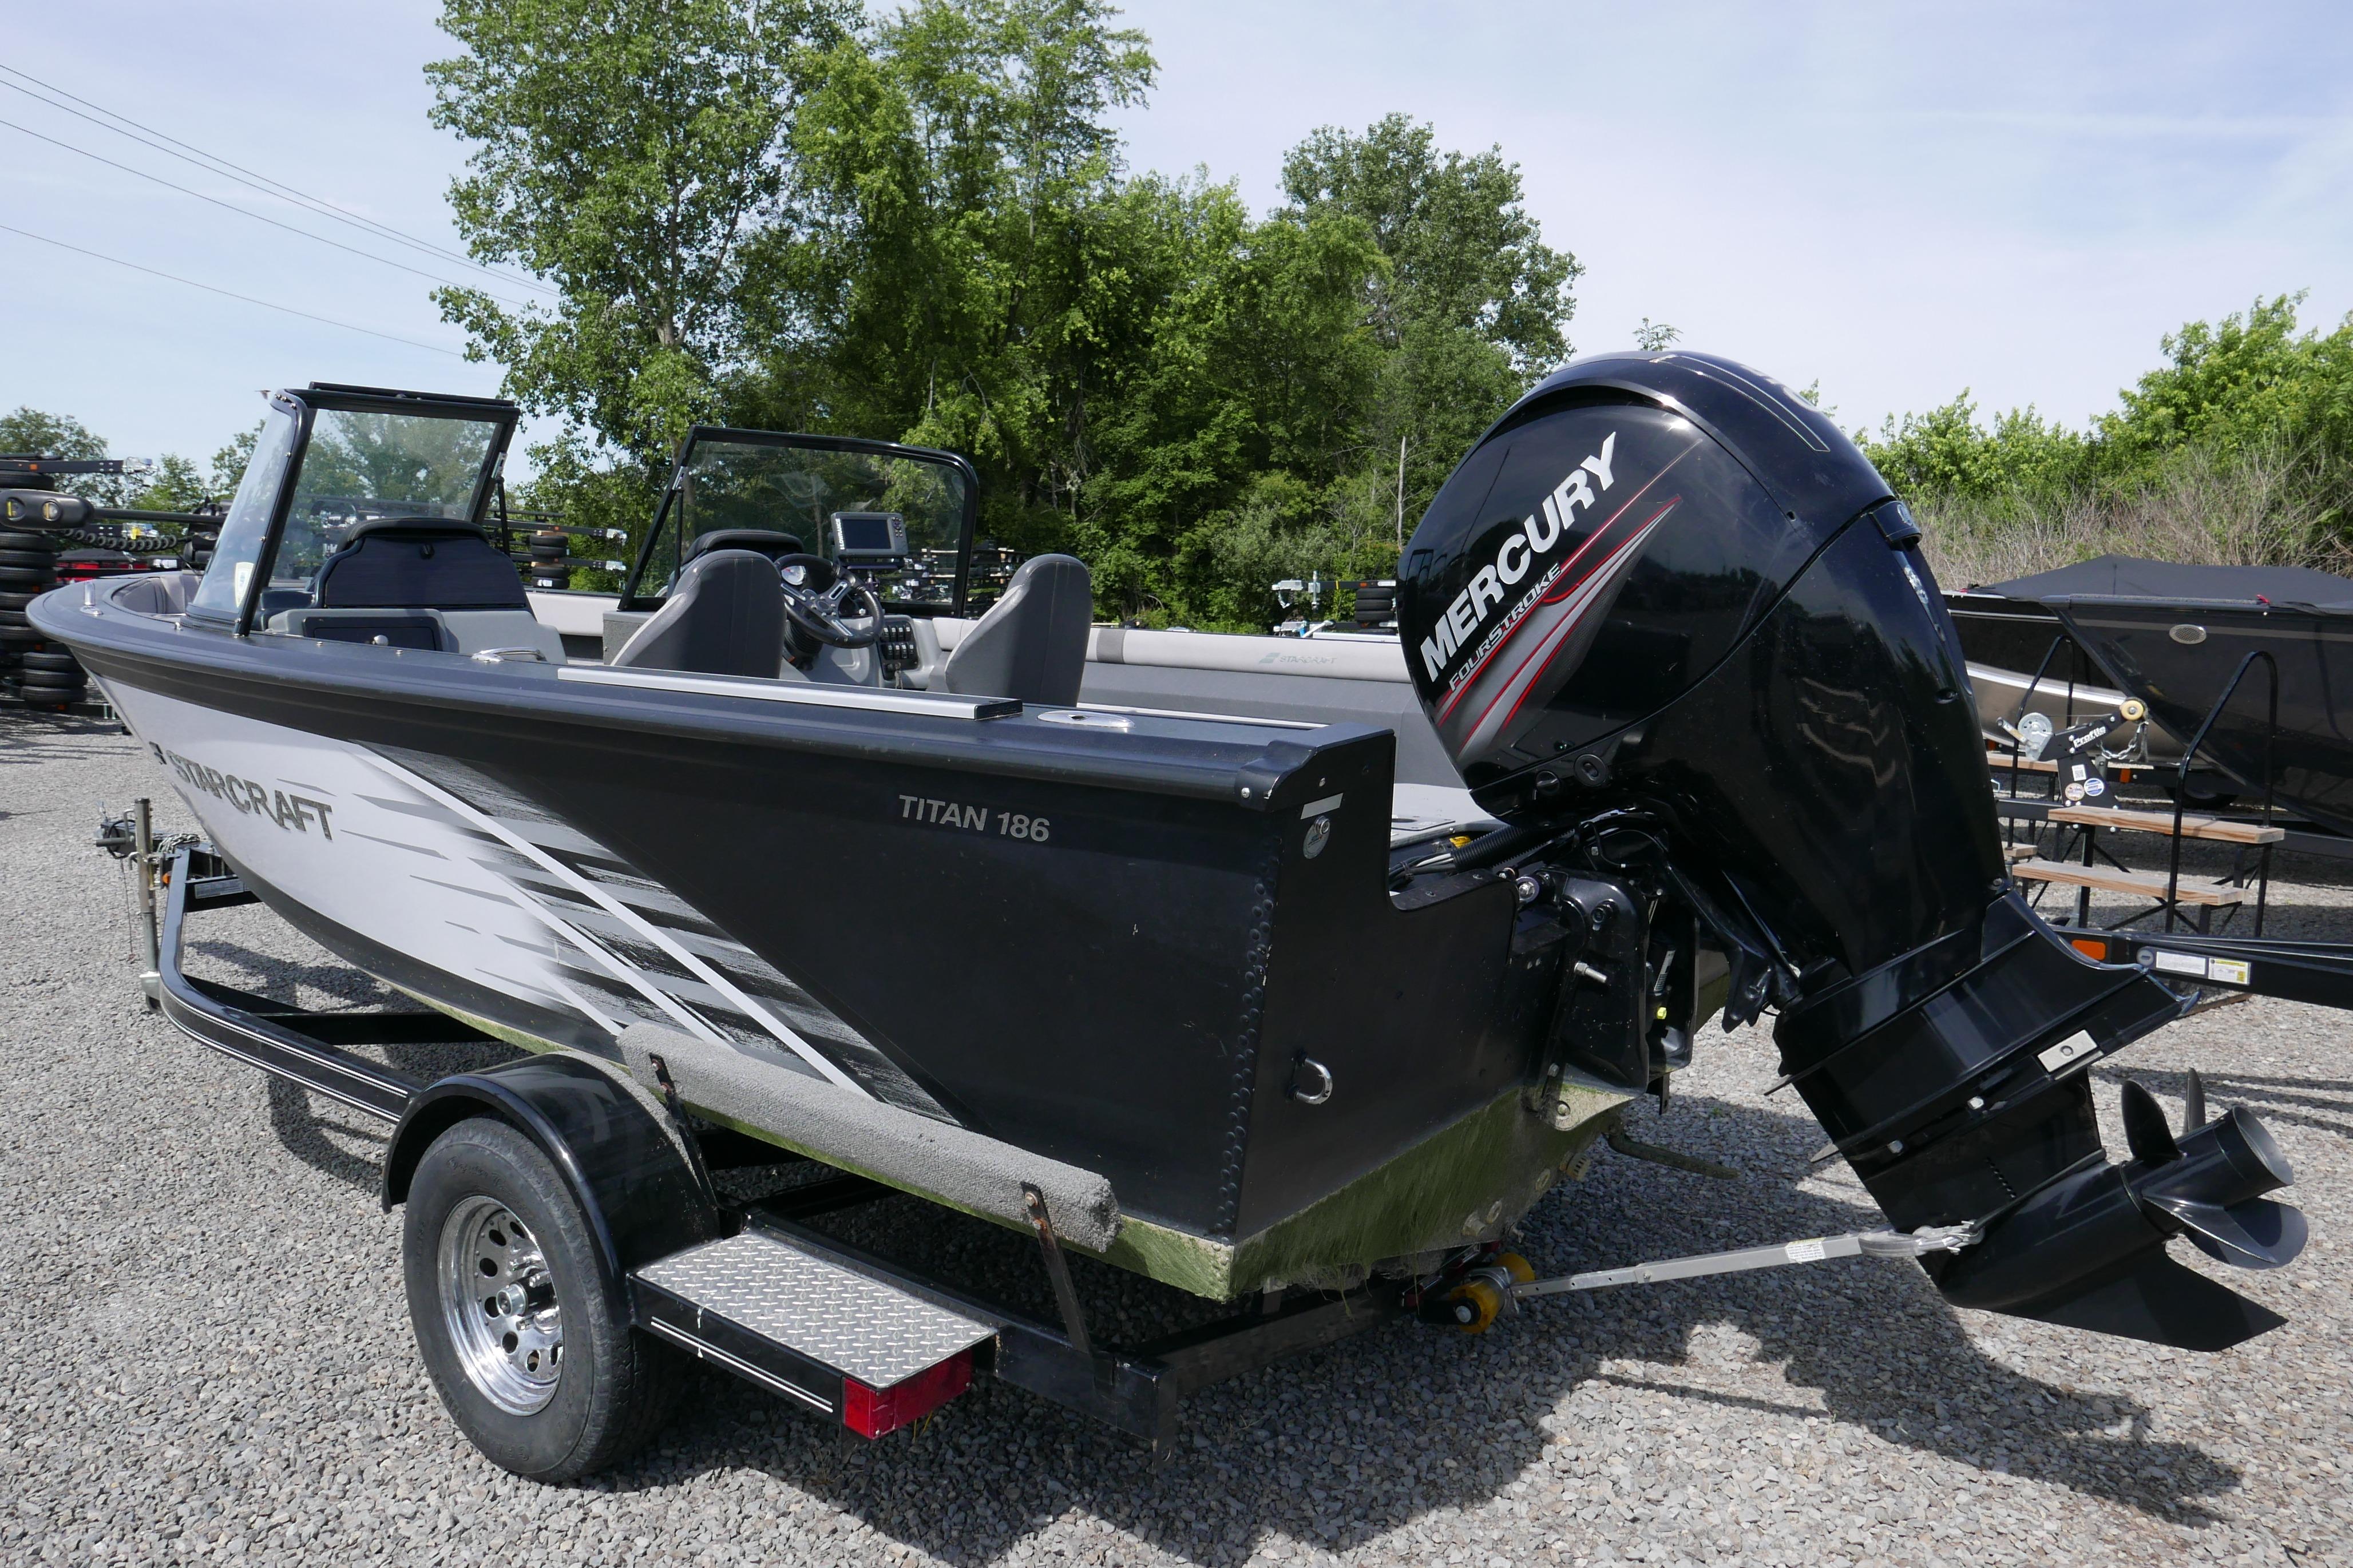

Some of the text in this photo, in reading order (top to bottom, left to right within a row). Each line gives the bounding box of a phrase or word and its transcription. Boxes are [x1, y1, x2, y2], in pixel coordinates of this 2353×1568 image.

[1420, 431, 1616, 682] MERCURY
[1448, 561, 1563, 692] FOURSTROKE
[166, 749, 333, 841] STARCRAFT
[899, 795, 1051, 842] TITAN 186
